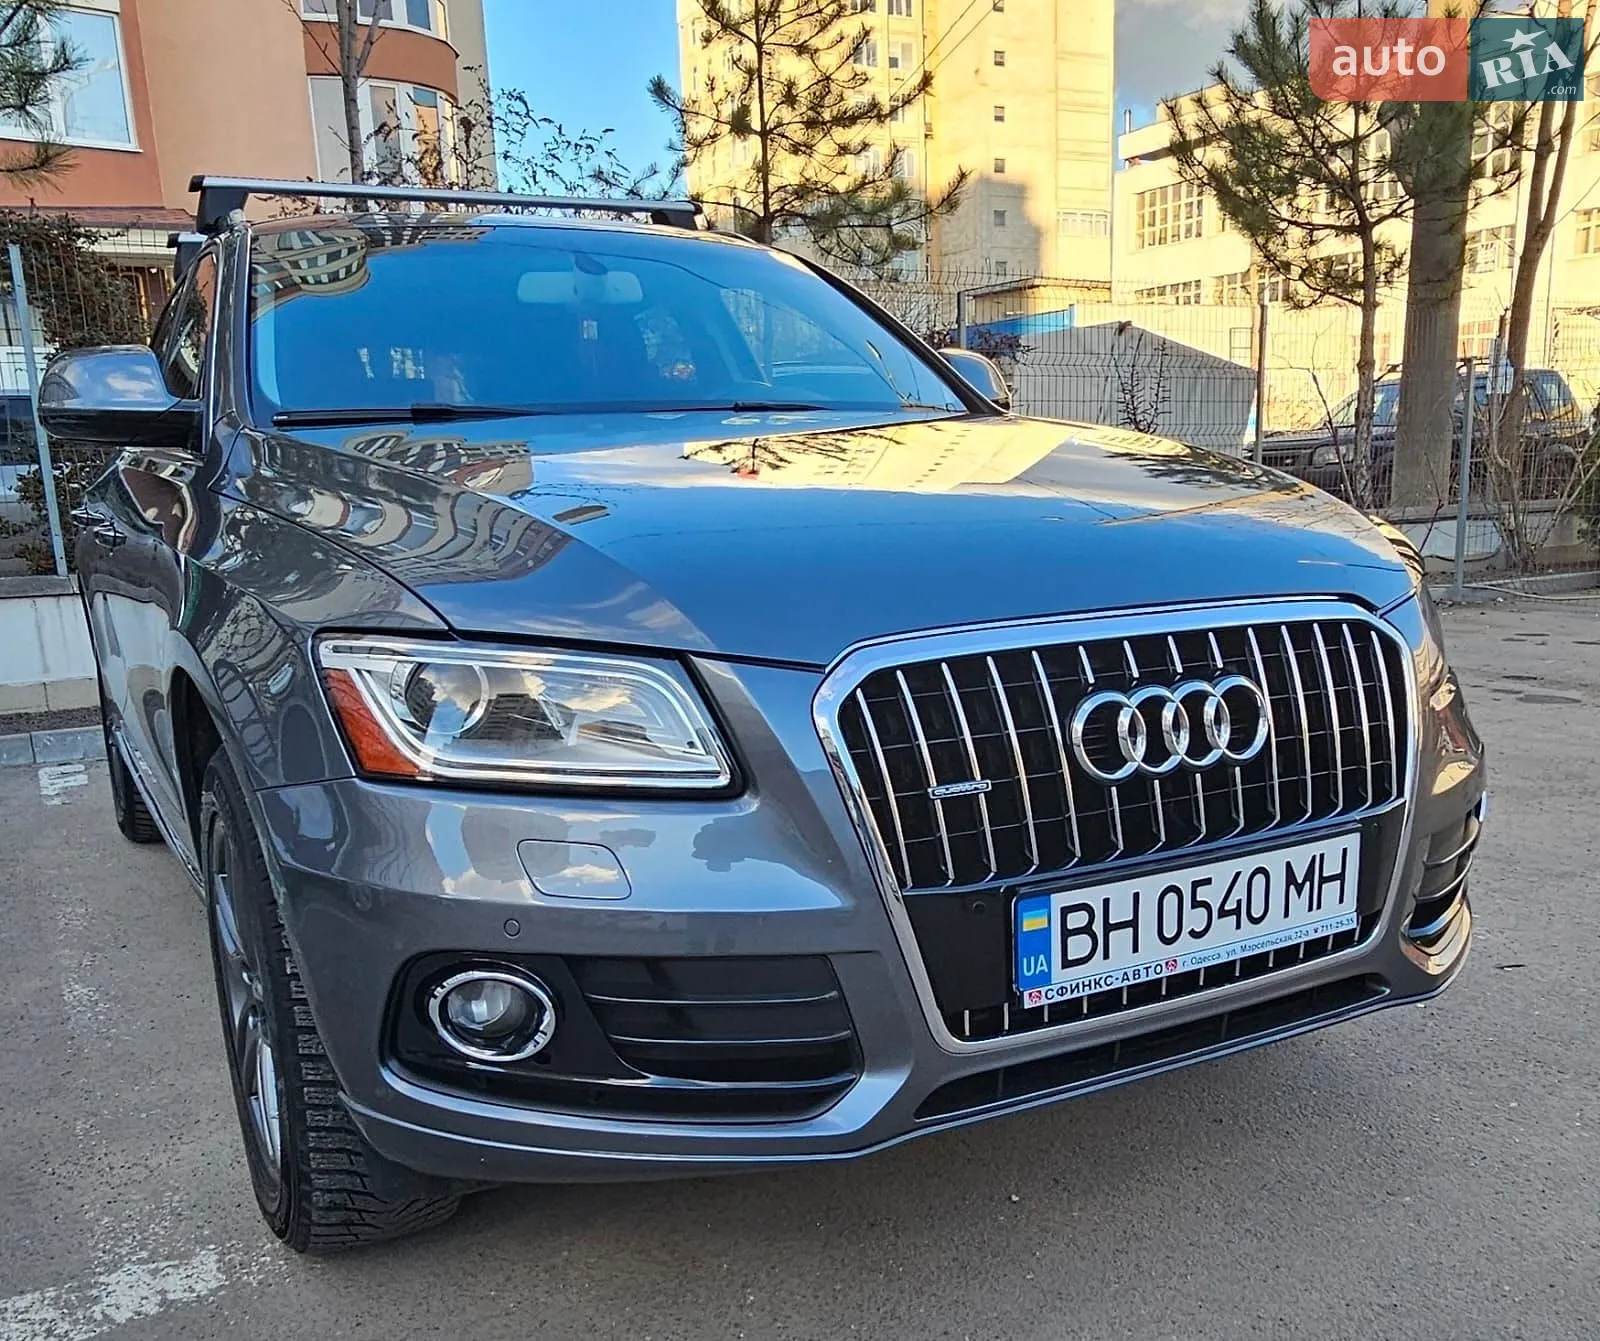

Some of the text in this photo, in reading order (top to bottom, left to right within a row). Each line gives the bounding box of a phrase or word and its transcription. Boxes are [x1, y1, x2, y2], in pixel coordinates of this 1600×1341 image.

[1060, 847, 1348, 970] BH 0540 MH
[1023, 953, 1049, 977] UA
[1044, 963, 1163, 1000] СФИНКС-АВТО
